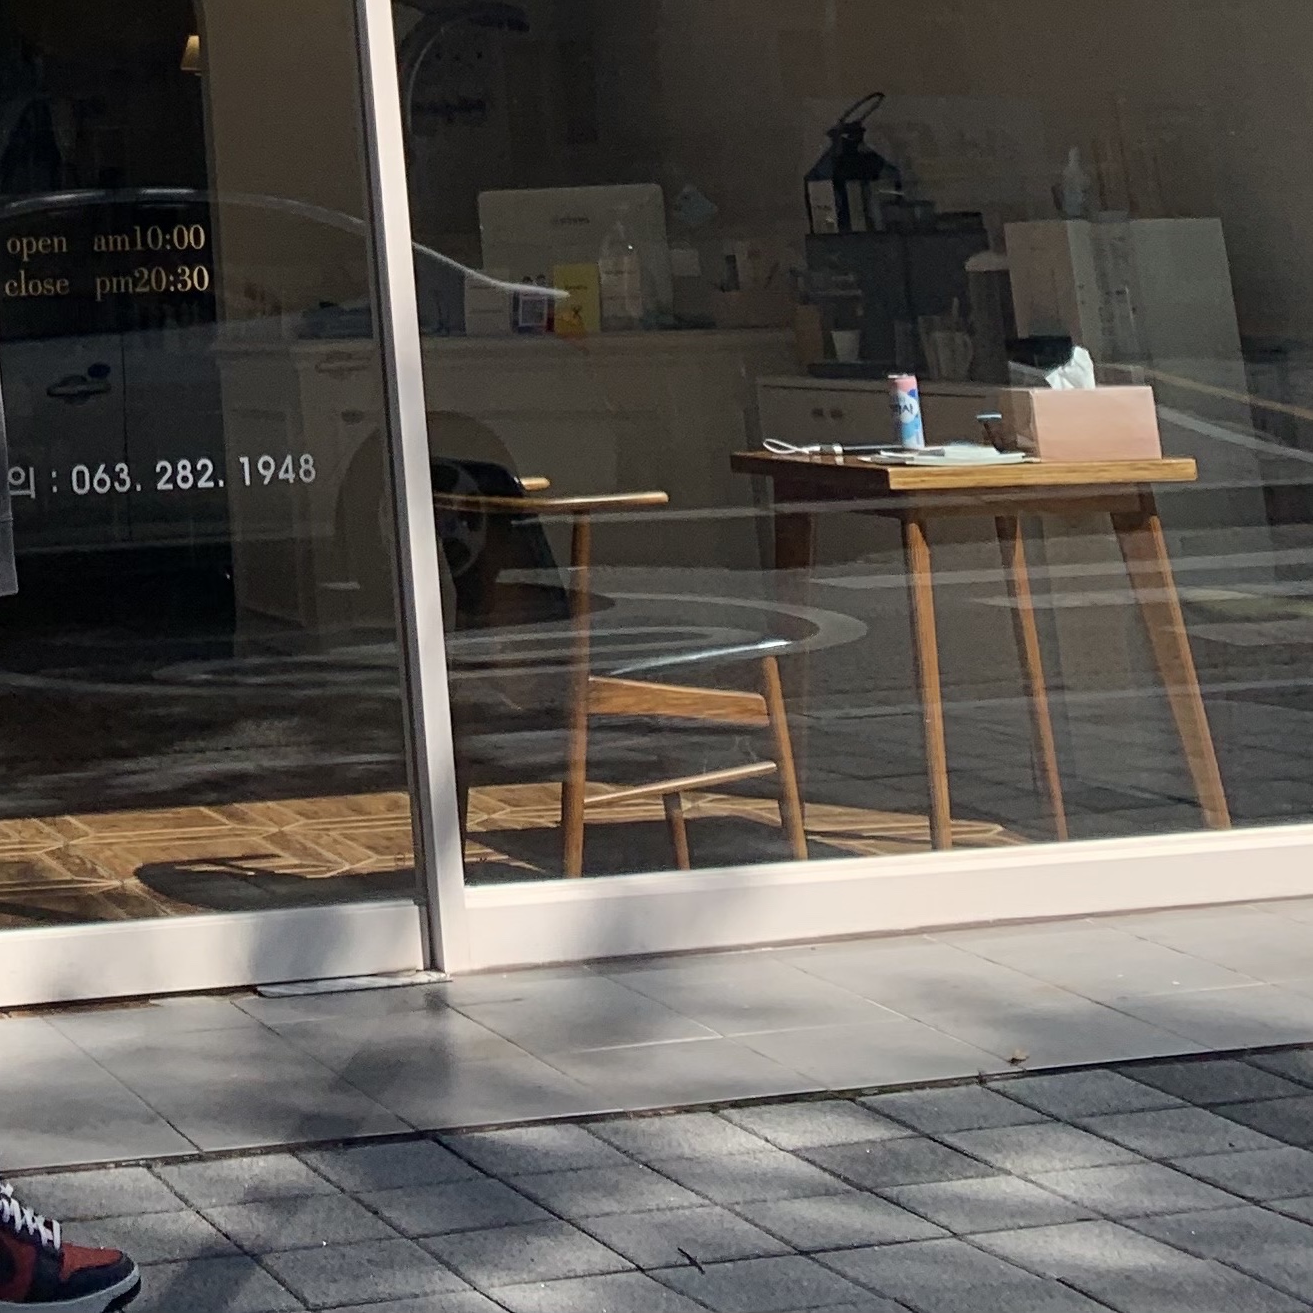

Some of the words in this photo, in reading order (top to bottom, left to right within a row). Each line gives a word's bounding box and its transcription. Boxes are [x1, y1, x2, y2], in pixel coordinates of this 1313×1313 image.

[6, 235, 68, 262] open
[93, 223, 206, 252] am10:00
[4, 269, 70, 297] close
[95, 265, 210, 302] pm20:30
[7, 466, 36, 499] 의
[70, 462, 142, 496] 063.
[155, 457, 226, 491] 282.
[238, 453, 317, 487] 1948
